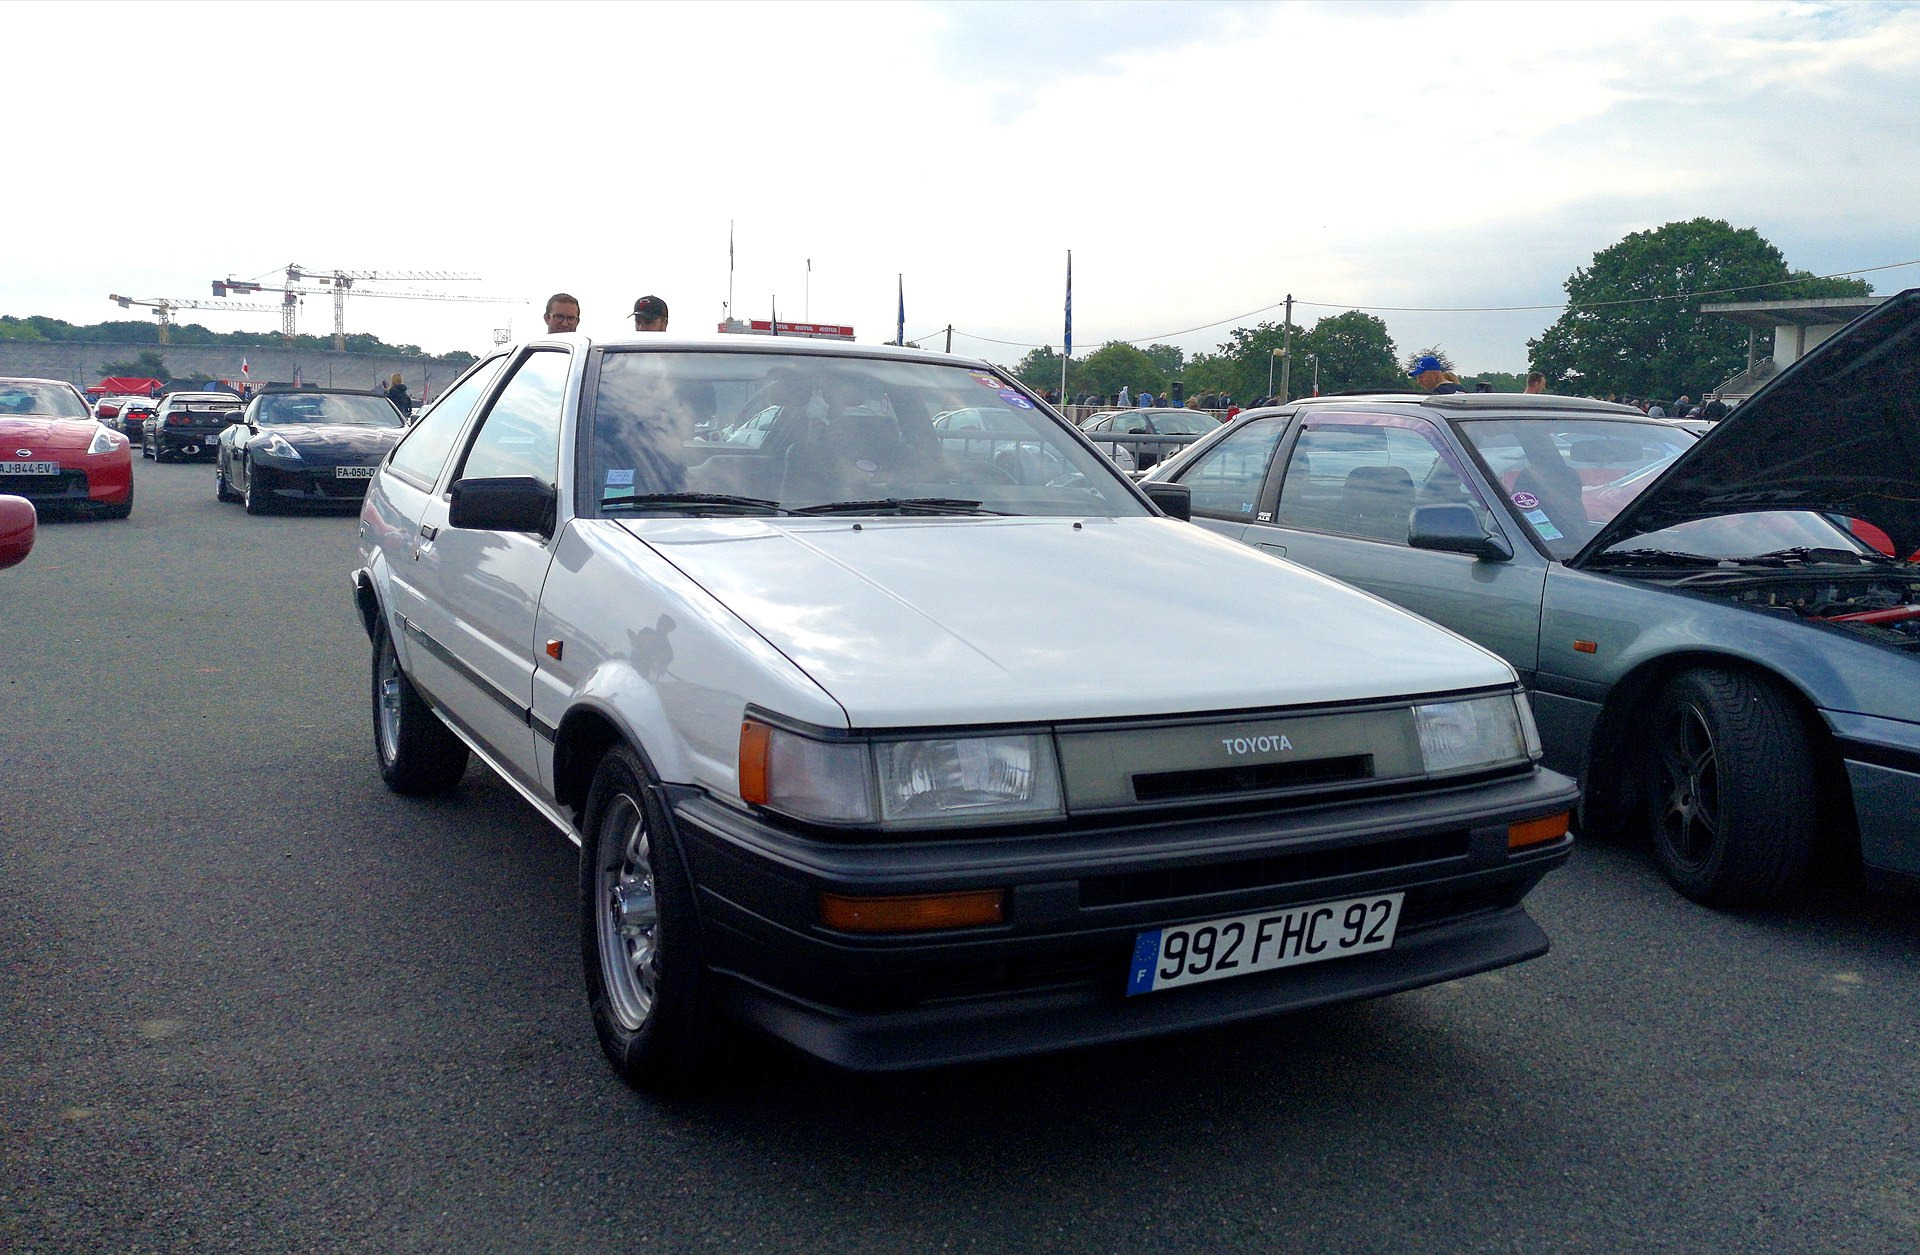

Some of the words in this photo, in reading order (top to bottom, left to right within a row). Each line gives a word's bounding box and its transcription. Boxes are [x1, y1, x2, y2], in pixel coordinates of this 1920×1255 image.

[794, 324, 813, 332] MOTUL
[982, 378, 1000, 388] 3
[1012, 397, 1031, 409] 3
[1222, 735, 1293, 755] TOYOTA
[1160, 922, 1245, 980] 992
[1251, 908, 1333, 964] FHC
[1339, 900, 1392, 949] 92
[1136, 969, 1147, 984] F
